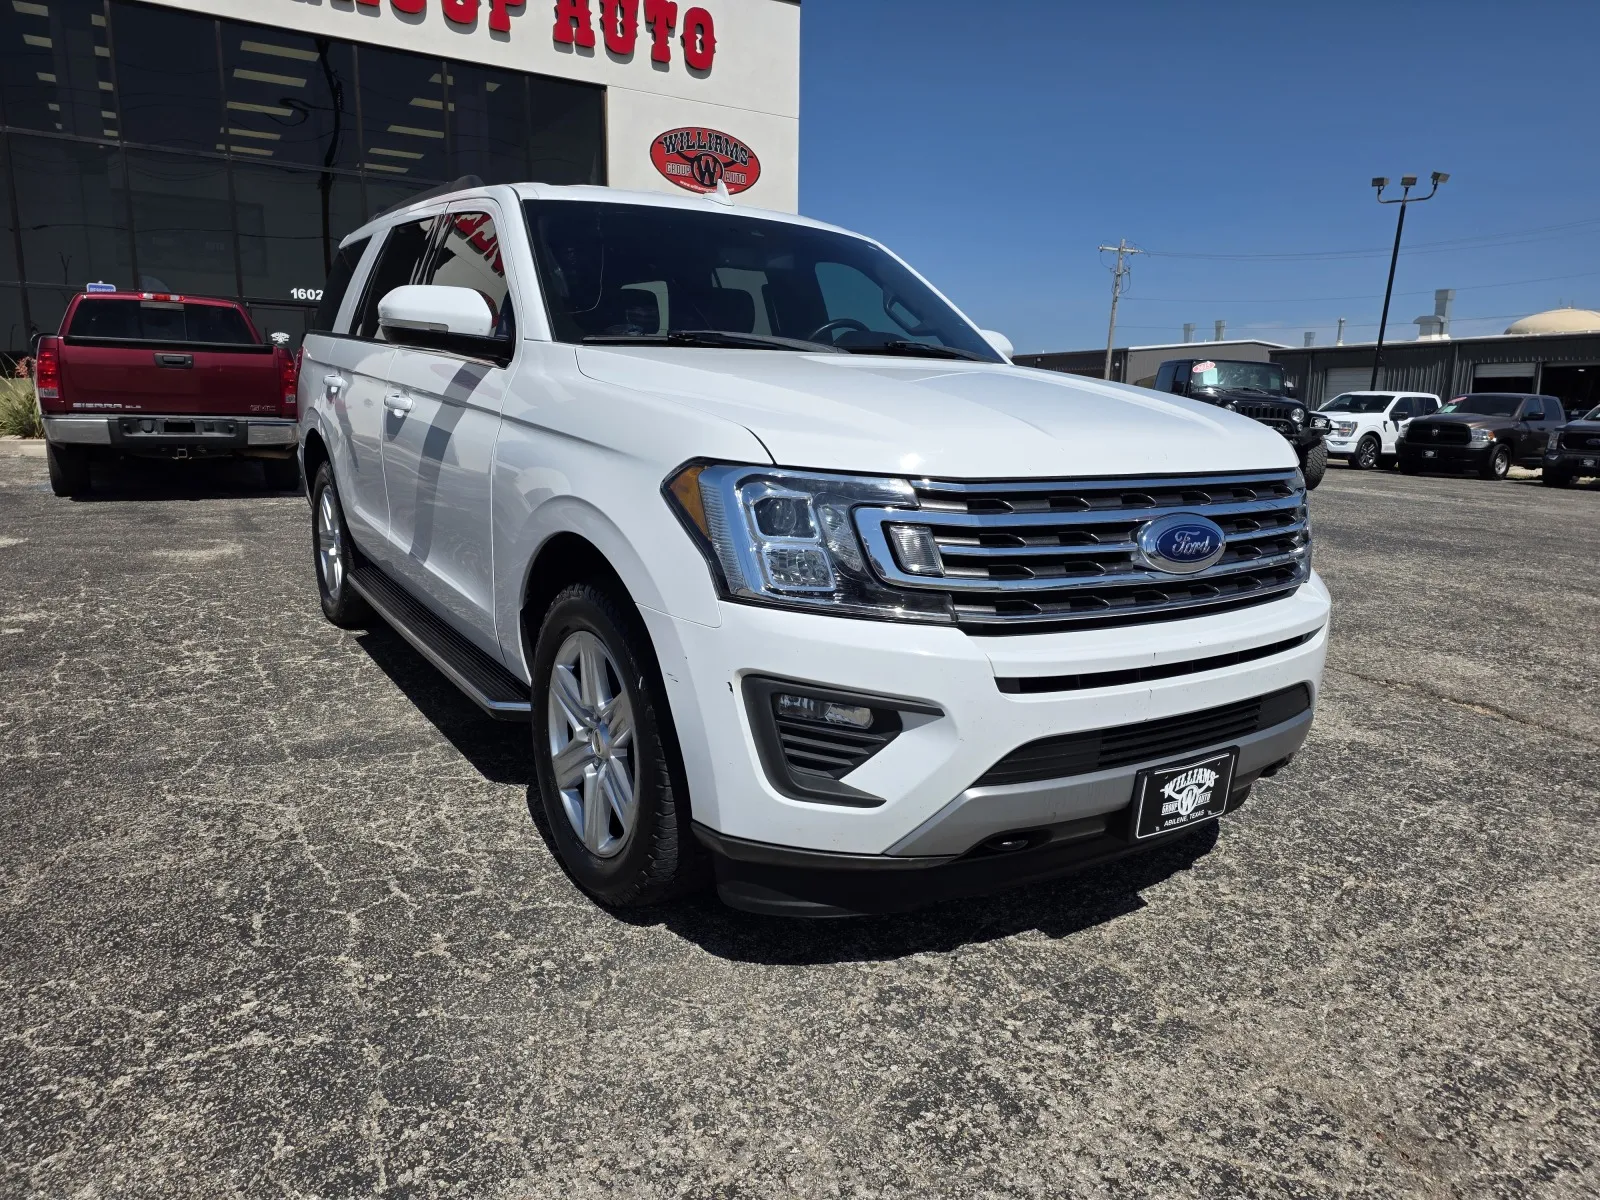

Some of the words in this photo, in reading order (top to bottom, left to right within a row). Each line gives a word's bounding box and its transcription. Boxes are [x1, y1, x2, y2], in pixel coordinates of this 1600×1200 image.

[553, 0, 717, 70] AUTO
[662, 131, 749, 167] WILLIAMS
[666, 162, 692, 176] GROUP
[693, 154, 721, 186] W
[724, 170, 747, 185] AUTO
[290, 287, 324, 301] 1602
[1171, 530, 1211, 556] Ford
[1163, 768, 1216, 799] WILLIAMS
[1163, 815, 1189, 827] ABILENE,
[1189, 809, 1205, 819] TEXAS
